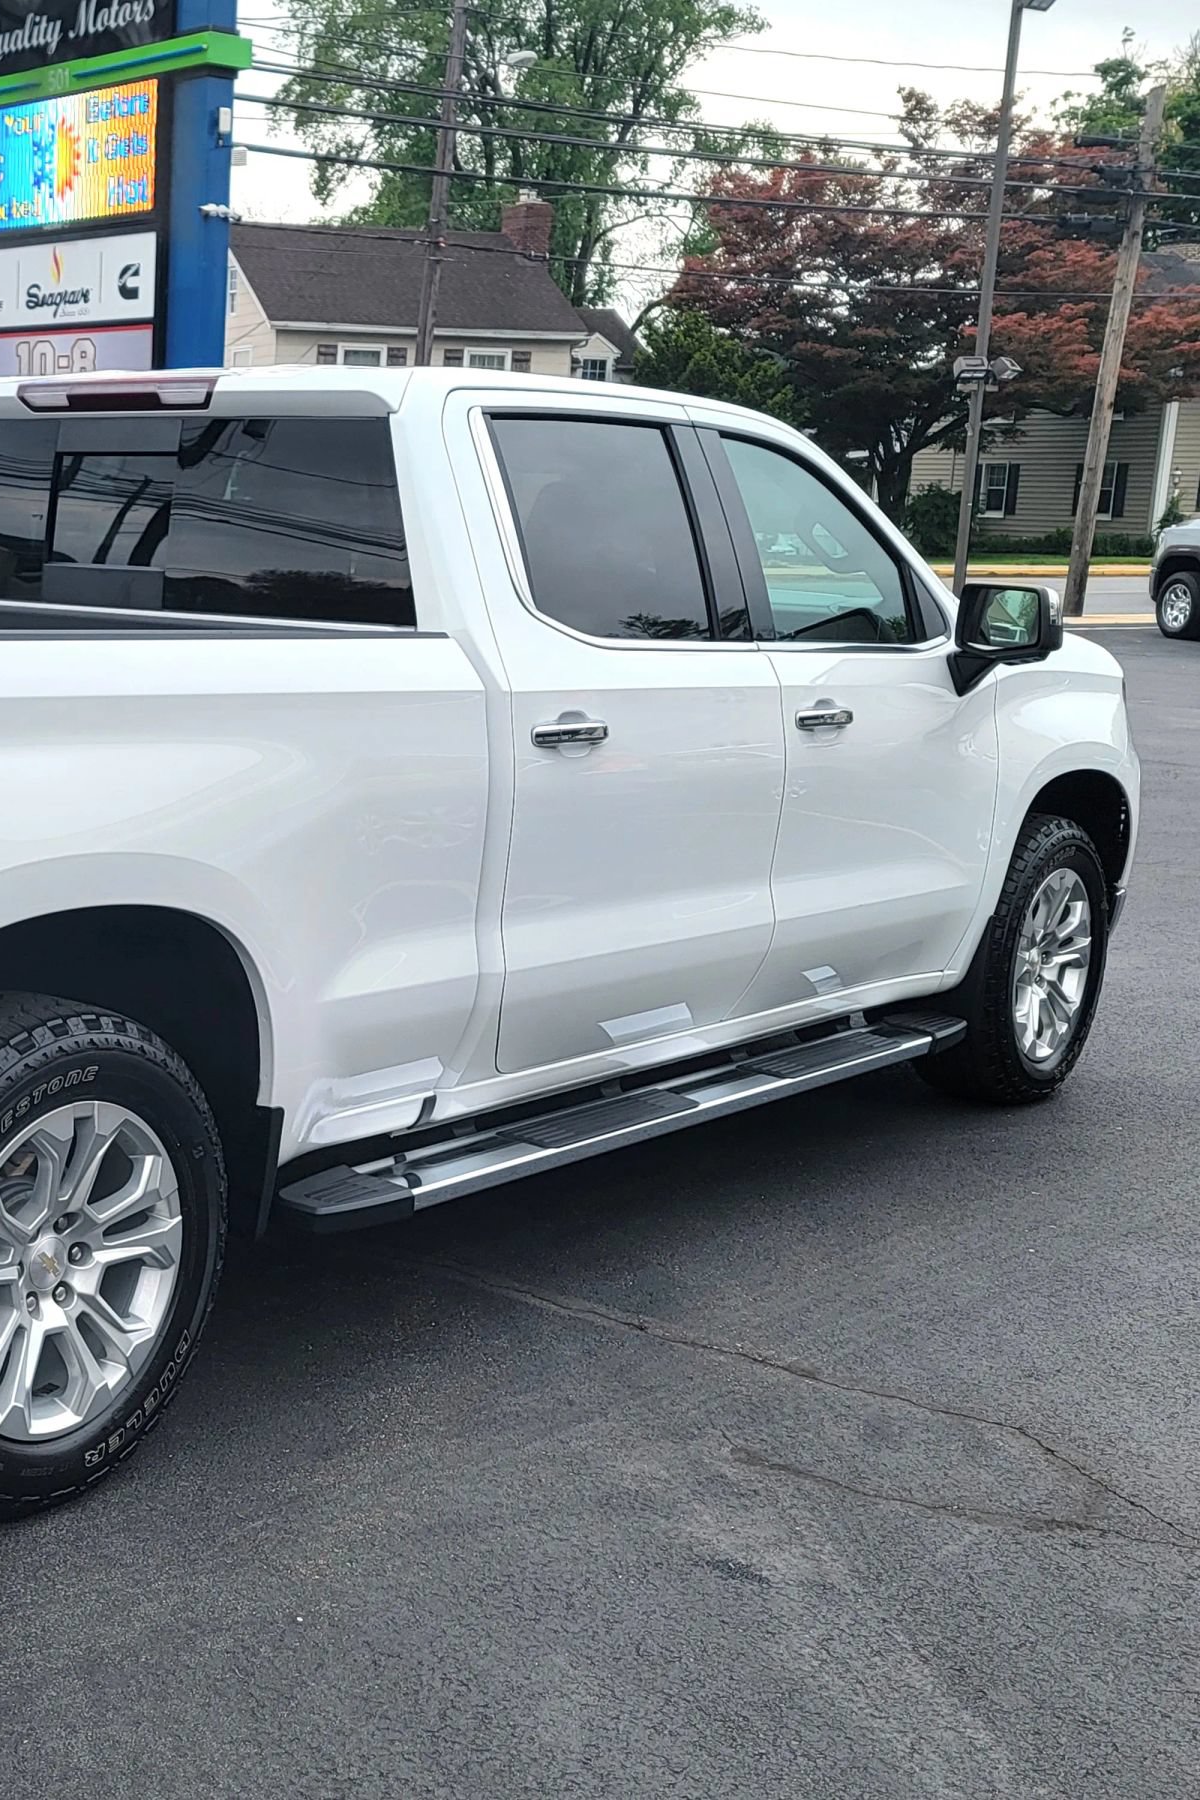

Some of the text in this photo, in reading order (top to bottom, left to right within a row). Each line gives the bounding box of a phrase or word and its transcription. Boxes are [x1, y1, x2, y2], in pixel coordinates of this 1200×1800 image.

[68, 0, 155, 39] Motors
[48, 68, 70, 91] 501
[25, 283, 91, 319] Seagrave
[16, 338, 97, 377] 10-8
[84, 1328, 191, 1468] DUELER
